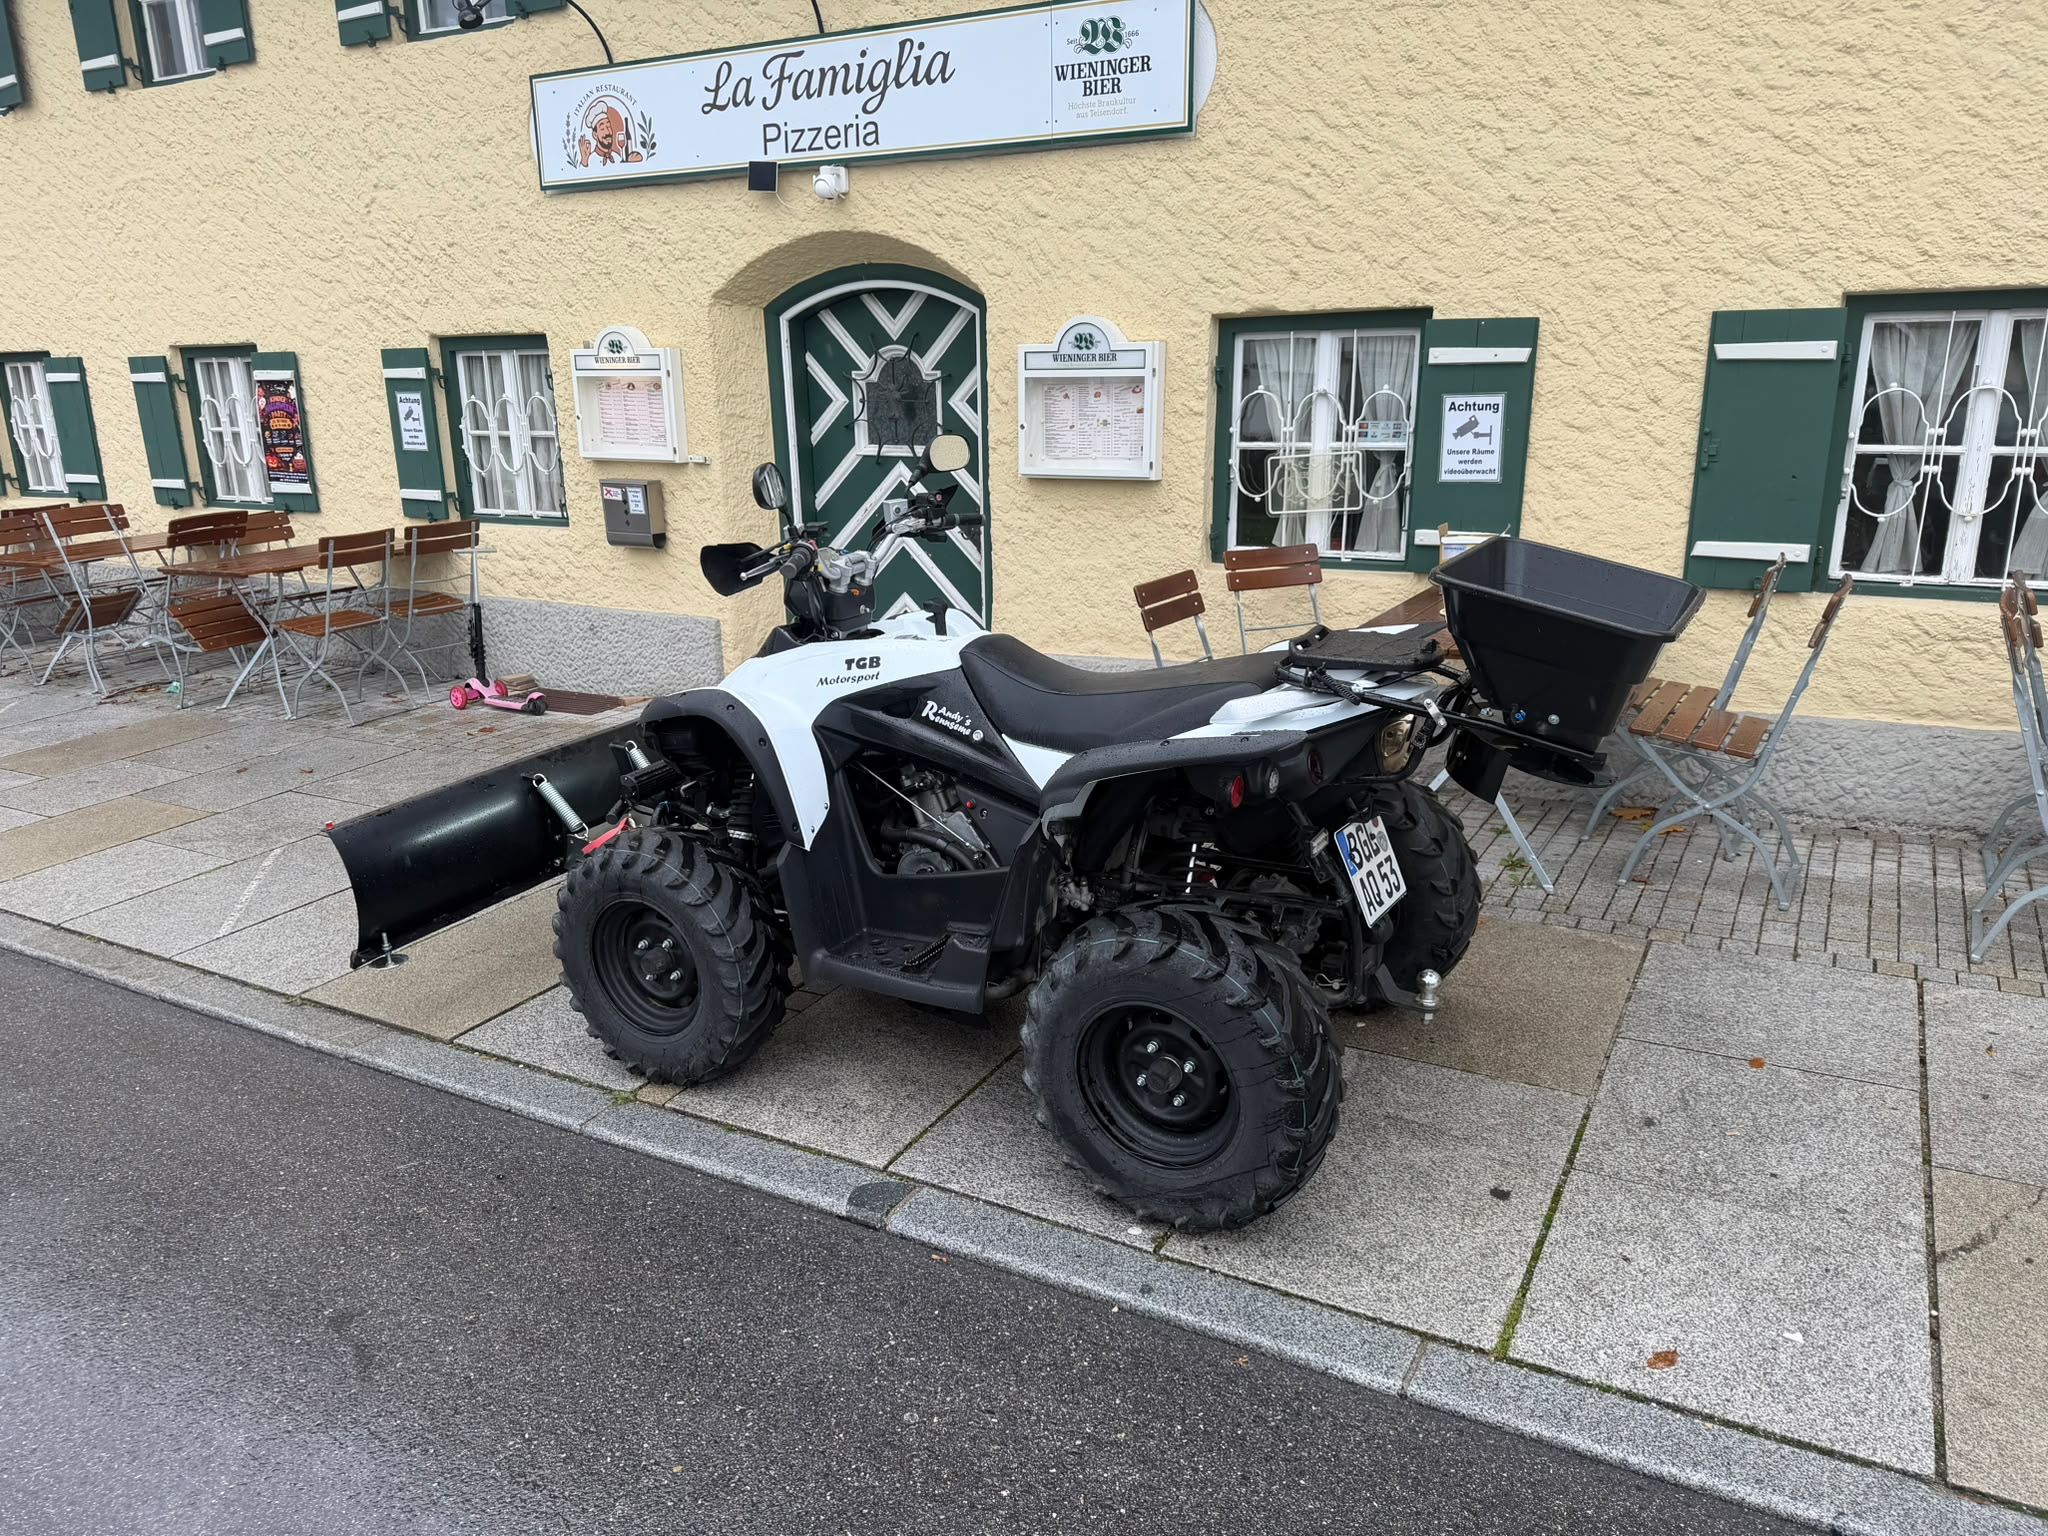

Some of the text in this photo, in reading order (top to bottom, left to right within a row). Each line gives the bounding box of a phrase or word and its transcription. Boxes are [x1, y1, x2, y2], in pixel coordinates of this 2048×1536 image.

[1124, 30, 1140, 38] 1666
[1054, 55, 1152, 82] WIENINGER
[701, 38, 956, 115] La Famiglia
[1082, 77, 1122, 97] BIER
[573, 84, 638, 117] ITALIAN RESTAURANT
[1068, 97, 1136, 111] Höchste Braukultur
[1076, 111, 1088, 119] aus
[763, 114, 880, 156] Pizzeria
[594, 356, 641, 364] WIENINGER BIER
[1052, 353, 1118, 363] WIENINGER BIER
[399, 396, 420, 406] Achtung
[1447, 401, 1500, 414] Achtung
[1443, 467, 1497, 475] videoüberwacht
[845, 655, 881, 671] TGB
[816, 671, 881, 688] Motorsport
[1359, 854, 1401, 917] AQ 53
